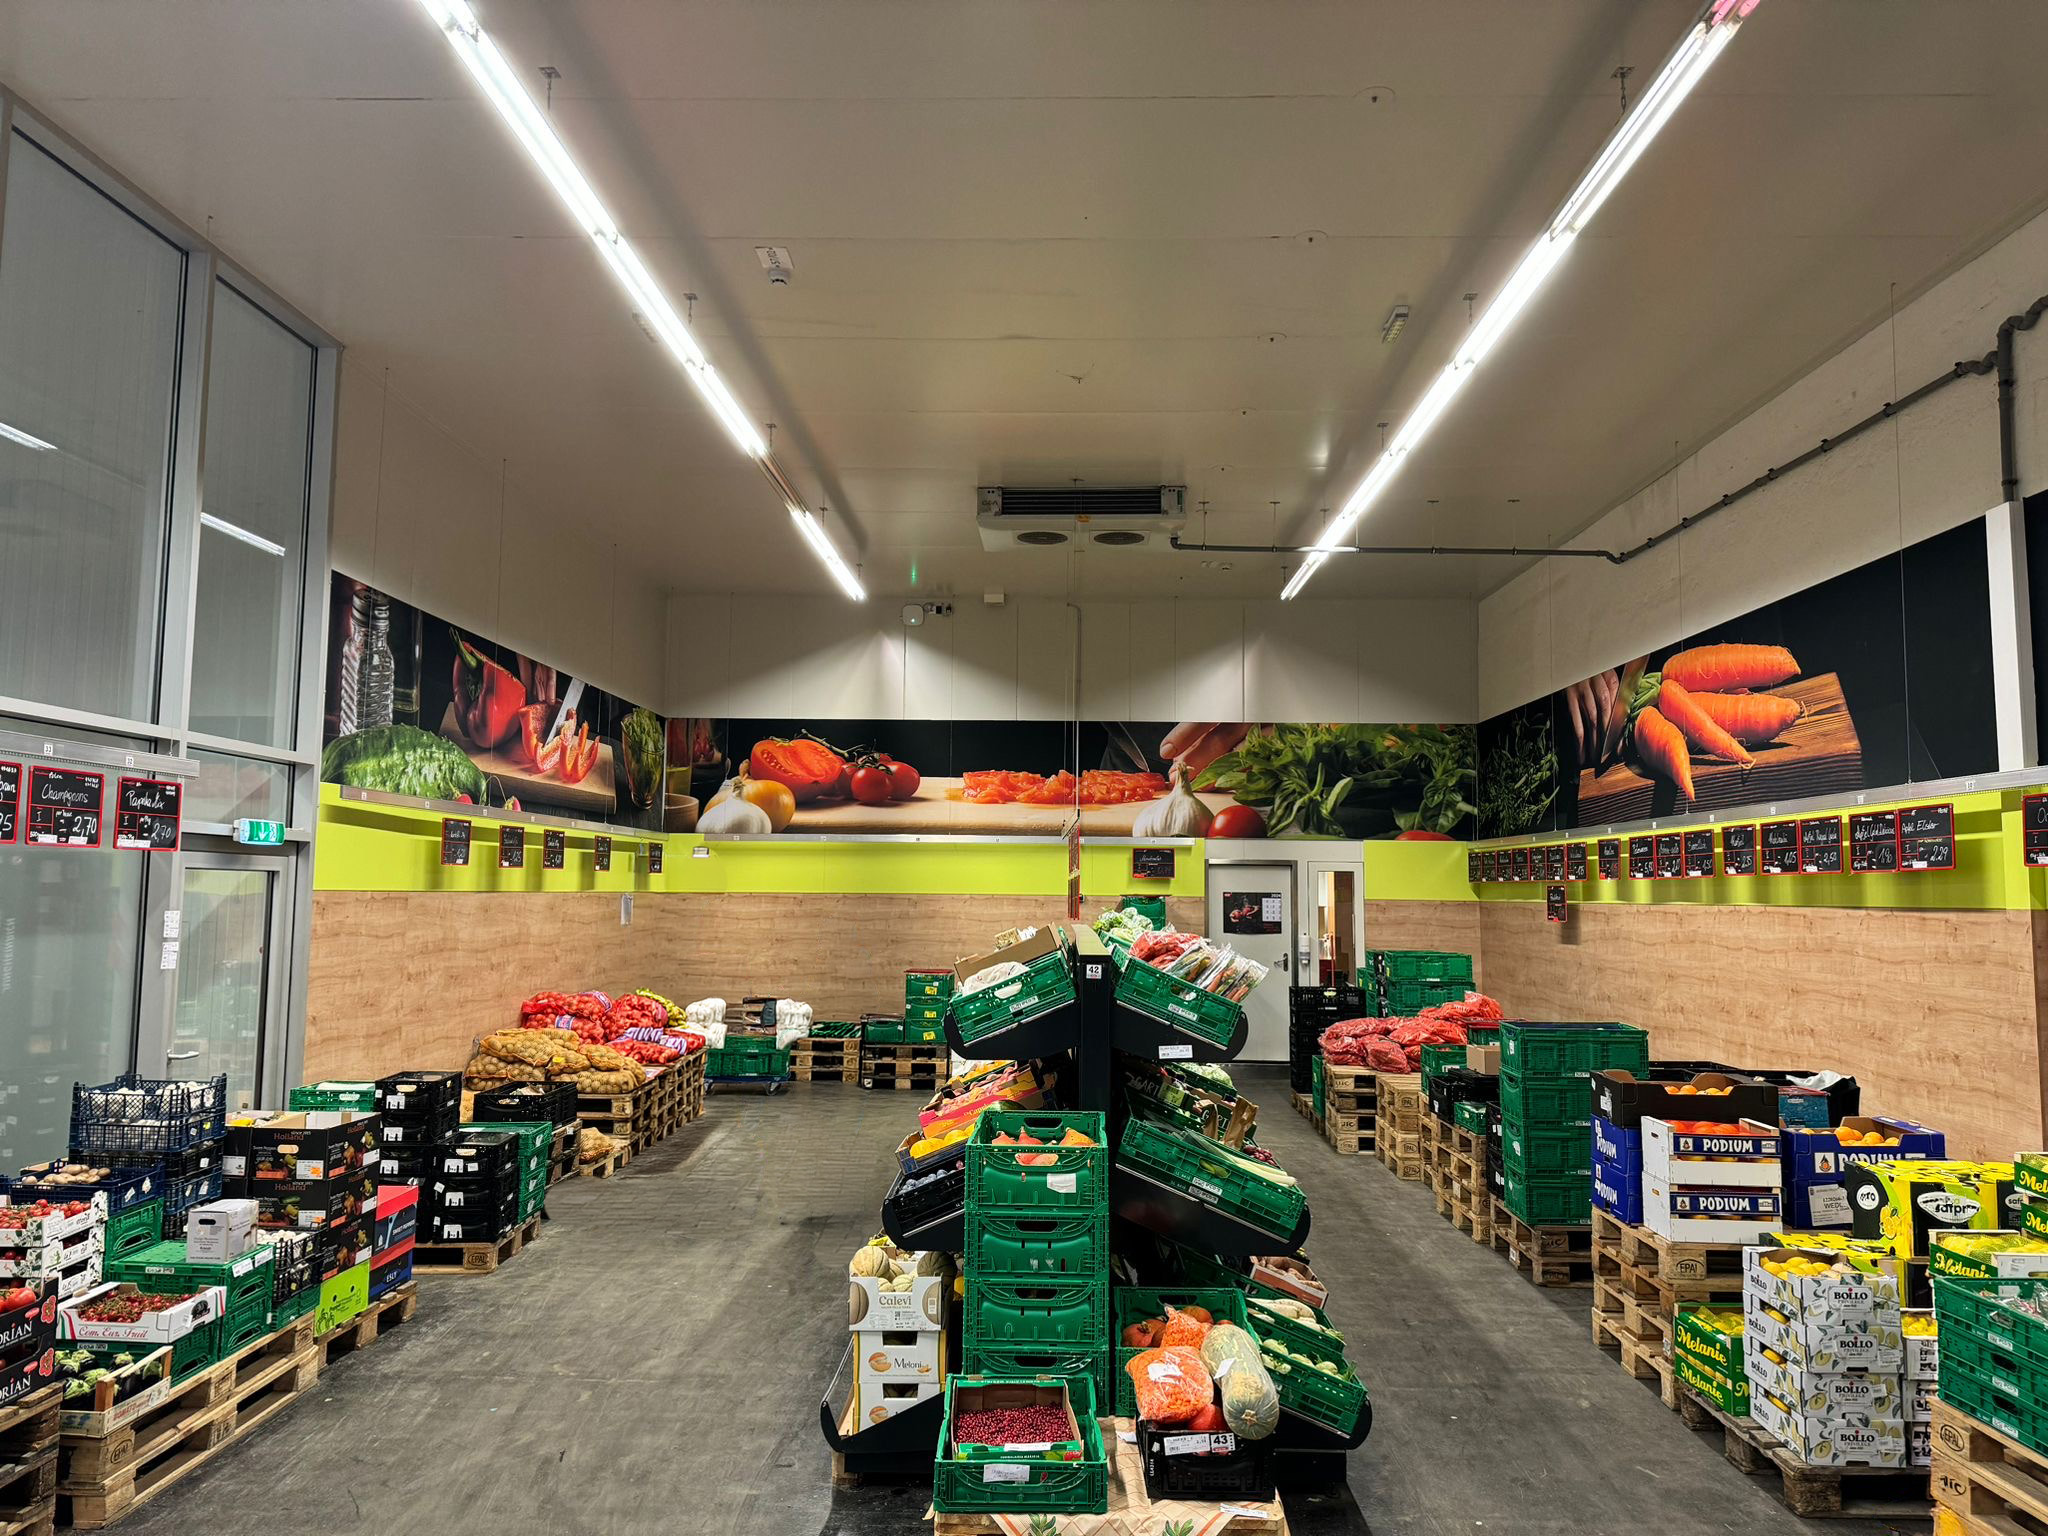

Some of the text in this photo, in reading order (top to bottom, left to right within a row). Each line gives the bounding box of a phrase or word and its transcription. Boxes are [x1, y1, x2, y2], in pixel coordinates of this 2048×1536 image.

[1088, 965, 1100, 974] 42
[1597, 1138, 1617, 1159] PODIUM
[1703, 1138, 1754, 1153] PODIUM
[1699, 1197, 1750, 1211] PODIUM
[1833, 1287, 1868, 1300] BOLLO
[880, 1295, 912, 1306] Calevi
[1676, 1325, 1728, 1366] Melanie
[1840, 1336, 1873, 1349] BOLLO
[894, 1358, 922, 1369] Meloni
[1681, 1362, 1724, 1402] Melanie
[1835, 1381, 1869, 1394] BOLLO
[1213, 1435, 1229, 1445] 43
[1840, 1430, 1875, 1442] BOLLO
